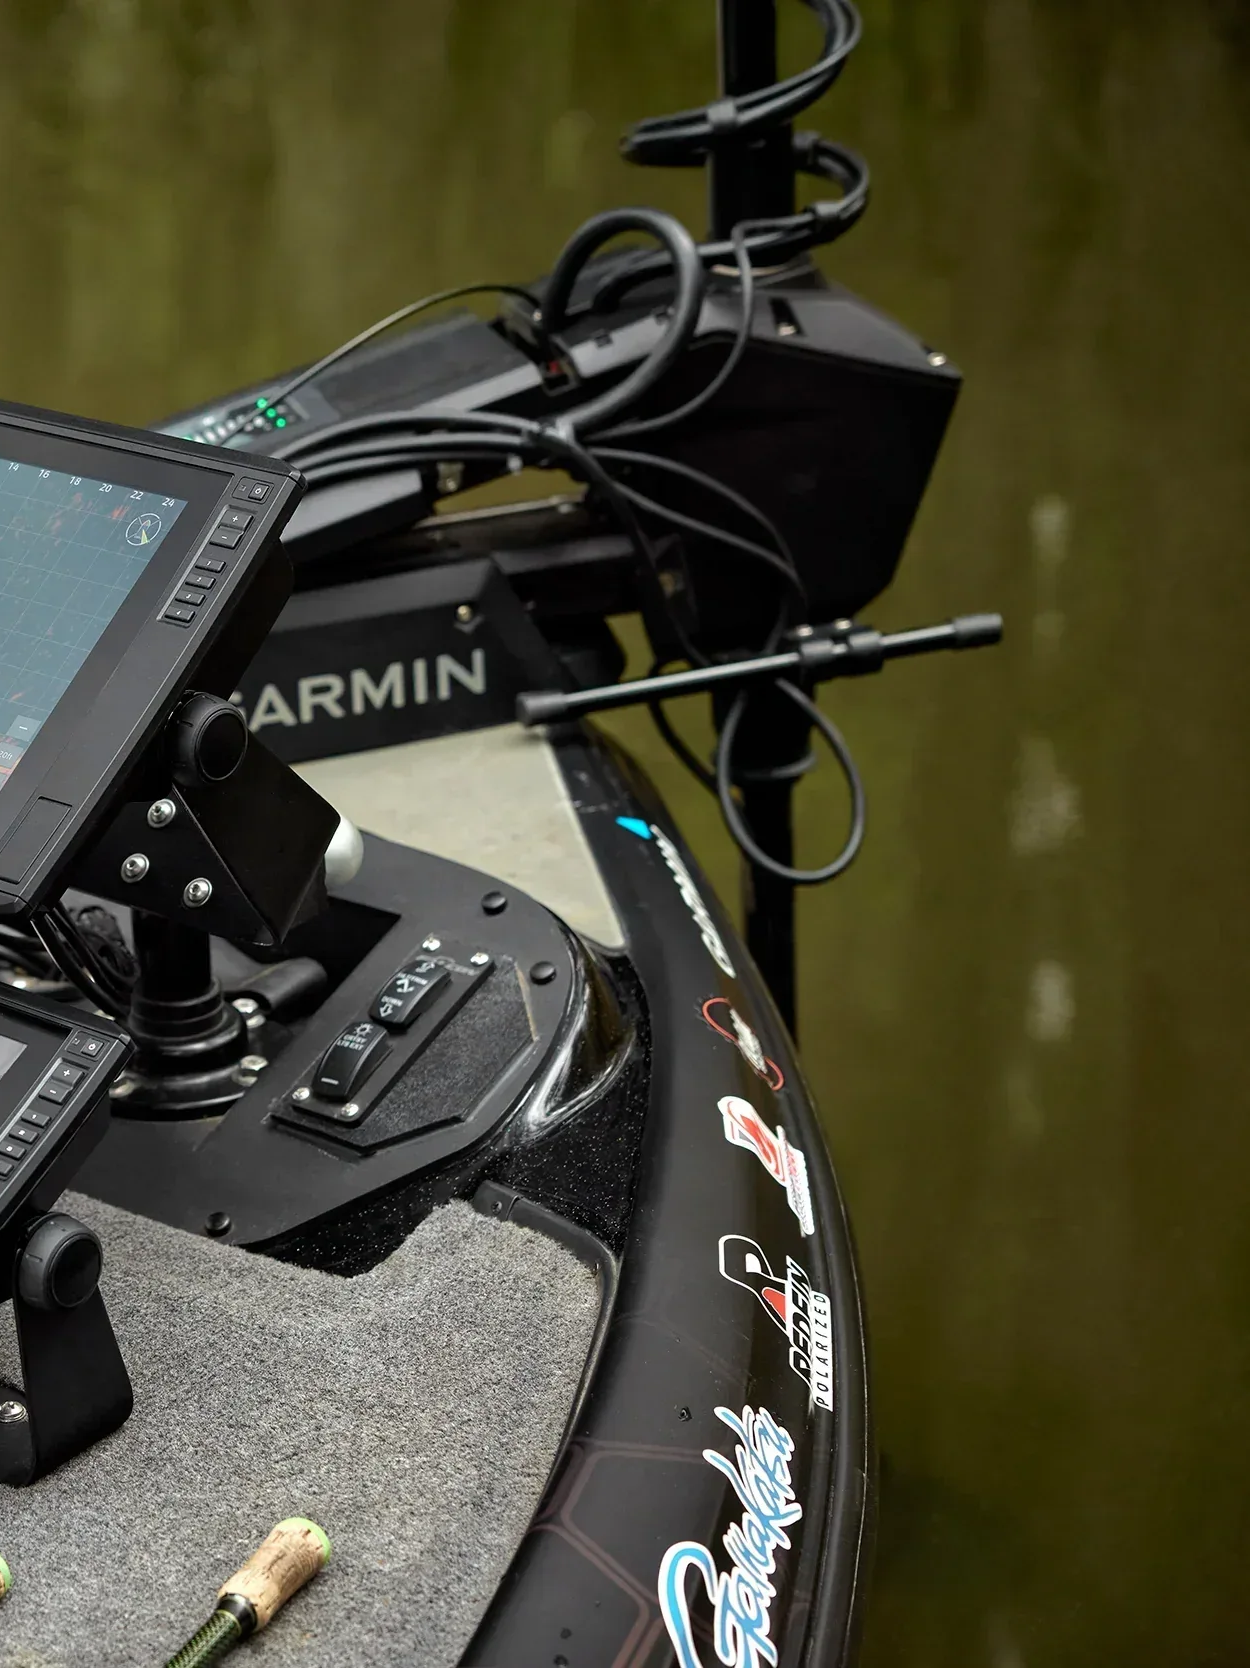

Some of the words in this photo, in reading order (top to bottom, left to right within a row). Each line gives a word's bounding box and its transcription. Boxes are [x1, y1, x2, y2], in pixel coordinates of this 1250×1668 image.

[7, 461, 20, 472] 14
[38, 468, 51, 479] 16
[68, 475, 82, 486] 18
[98, 482, 113, 493] 20
[129, 489, 144, 500] 22
[161, 497, 175, 508] 24
[813, 1294, 830, 1407] POLARIZED
